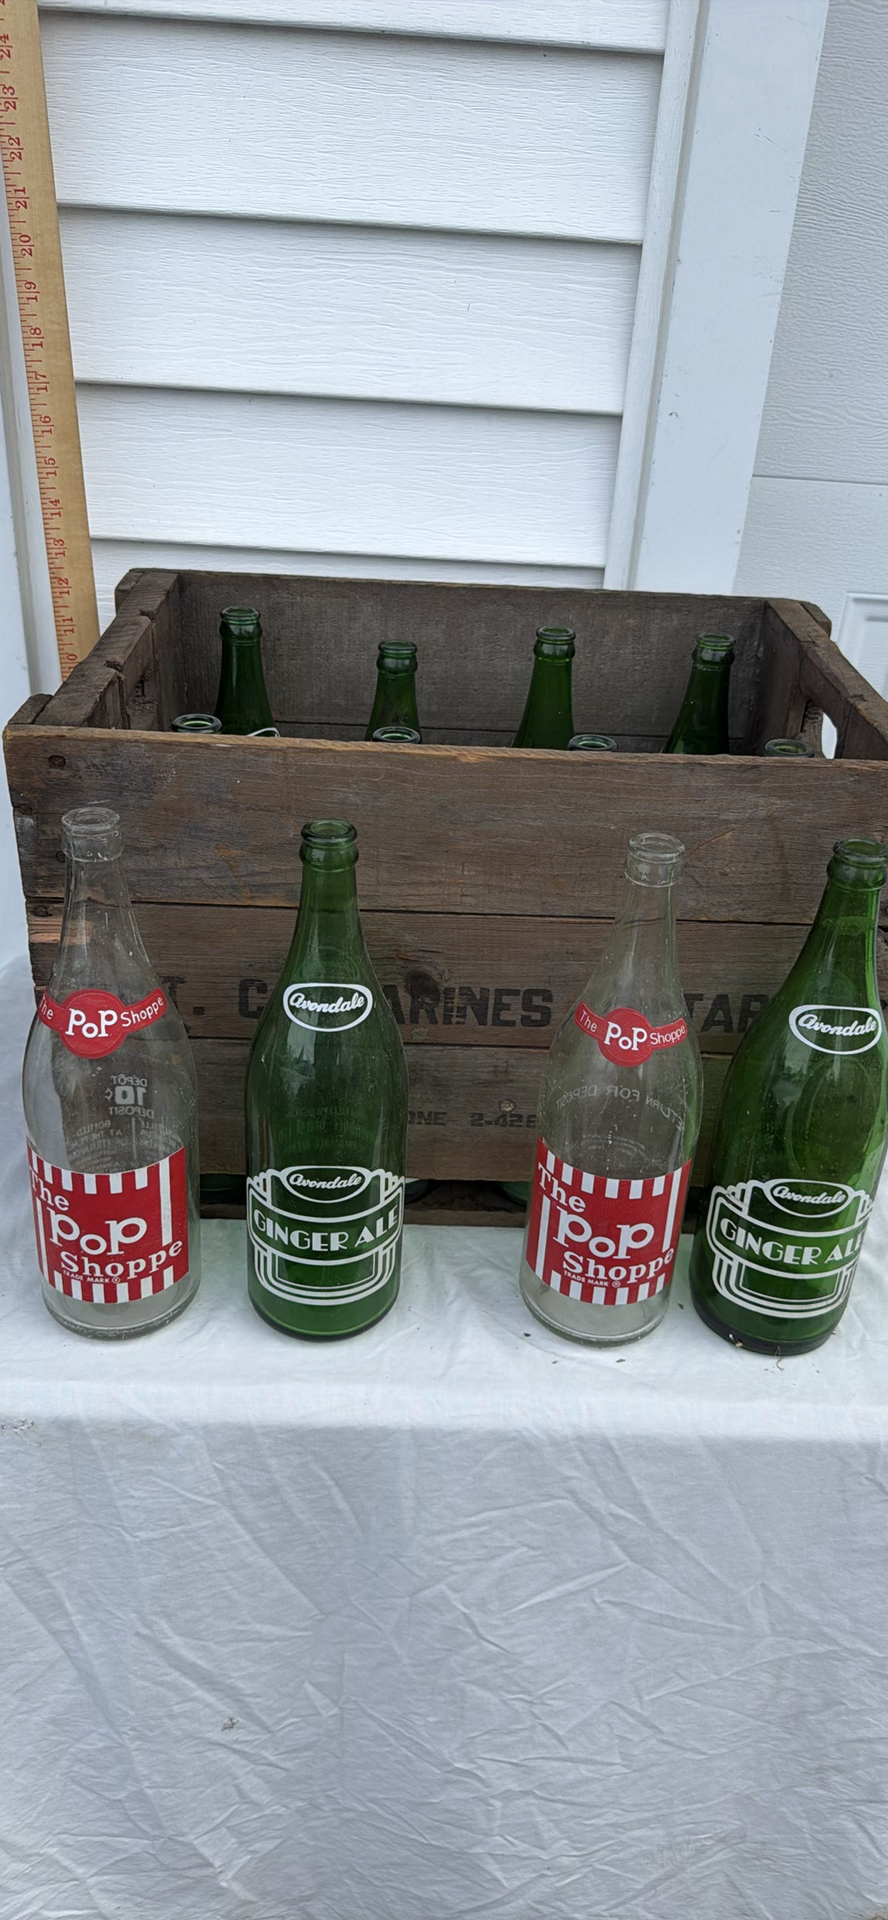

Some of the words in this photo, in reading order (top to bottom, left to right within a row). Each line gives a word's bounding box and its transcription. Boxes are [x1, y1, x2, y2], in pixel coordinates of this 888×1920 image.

[0, 33, 12, 60] 24
[3, 86, 17, 110] 23
[8, 137, 22, 161] 22
[14, 187, 27, 209] 21
[19, 234, 33, 257] 20
[25, 281, 38, 302] 19
[30, 327, 43, 349] 18
[35, 373, 48, 392] 17
[40, 415, 52, 435] 16
[45, 457, 57, 477] 15
[49, 499, 61, 518] 14
[53, 539, 65, 557] 13
[57, 578, 70, 596] 12
[62, 617, 74, 634] 11
[38, 995, 54, 1020] The
[120, 996, 164, 1027] Shoppe
[289, 992, 365, 1014] Avondale
[579, 1009, 597, 1033] The
[650, 1025, 686, 1046] Shoppe
[798, 1013, 878, 1037] Avondale
[30, 1166, 69, 1211] The
[289, 1173, 362, 1190] Avondale
[537, 1162, 586, 1213] The
[772, 1185, 848, 1205] Avondale
[253, 1209, 349, 1251] GINGER
[354, 1204, 398, 1248] ALE
[720, 1217, 822, 1266] GINGER
[824, 1228, 865, 1264] ALE
[60, 1240, 183, 1280] Shoppe
[562, 1247, 675, 1284] Shoppe
[63, 1269, 84, 1281] TRADE
[563, 1270, 586, 1283] TRADE
[587, 1278, 609, 1287] MARK
